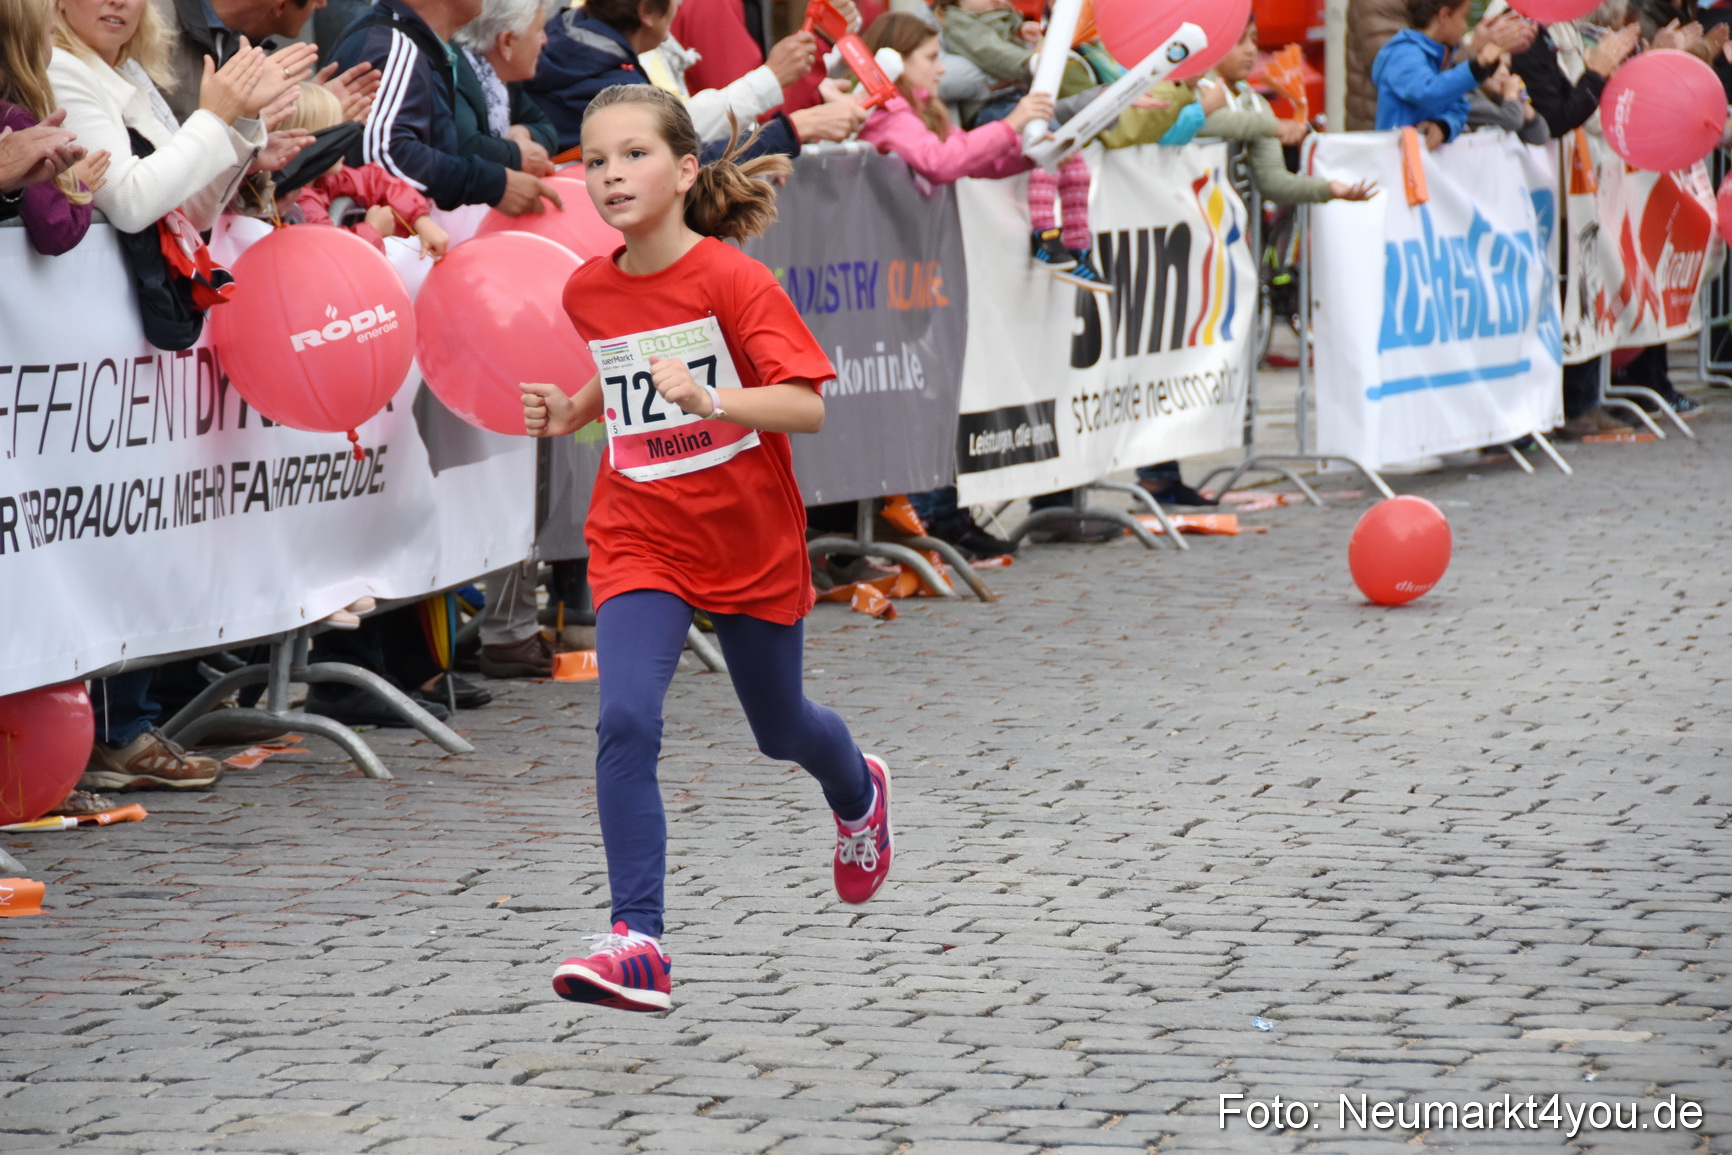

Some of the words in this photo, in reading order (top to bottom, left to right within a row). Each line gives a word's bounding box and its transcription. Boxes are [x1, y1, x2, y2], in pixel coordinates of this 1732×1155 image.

[289, 303, 397, 352] RÖDL
[356, 320, 399, 343] energie
[638, 326, 711, 356] BOCK
[605, 354, 717, 426] 727
[613, 425, 618, 434] 5
[646, 431, 713, 459] Melina
[173, 464, 225, 528] MEHR
[230, 444, 388, 515] FAHRFREUDE.
